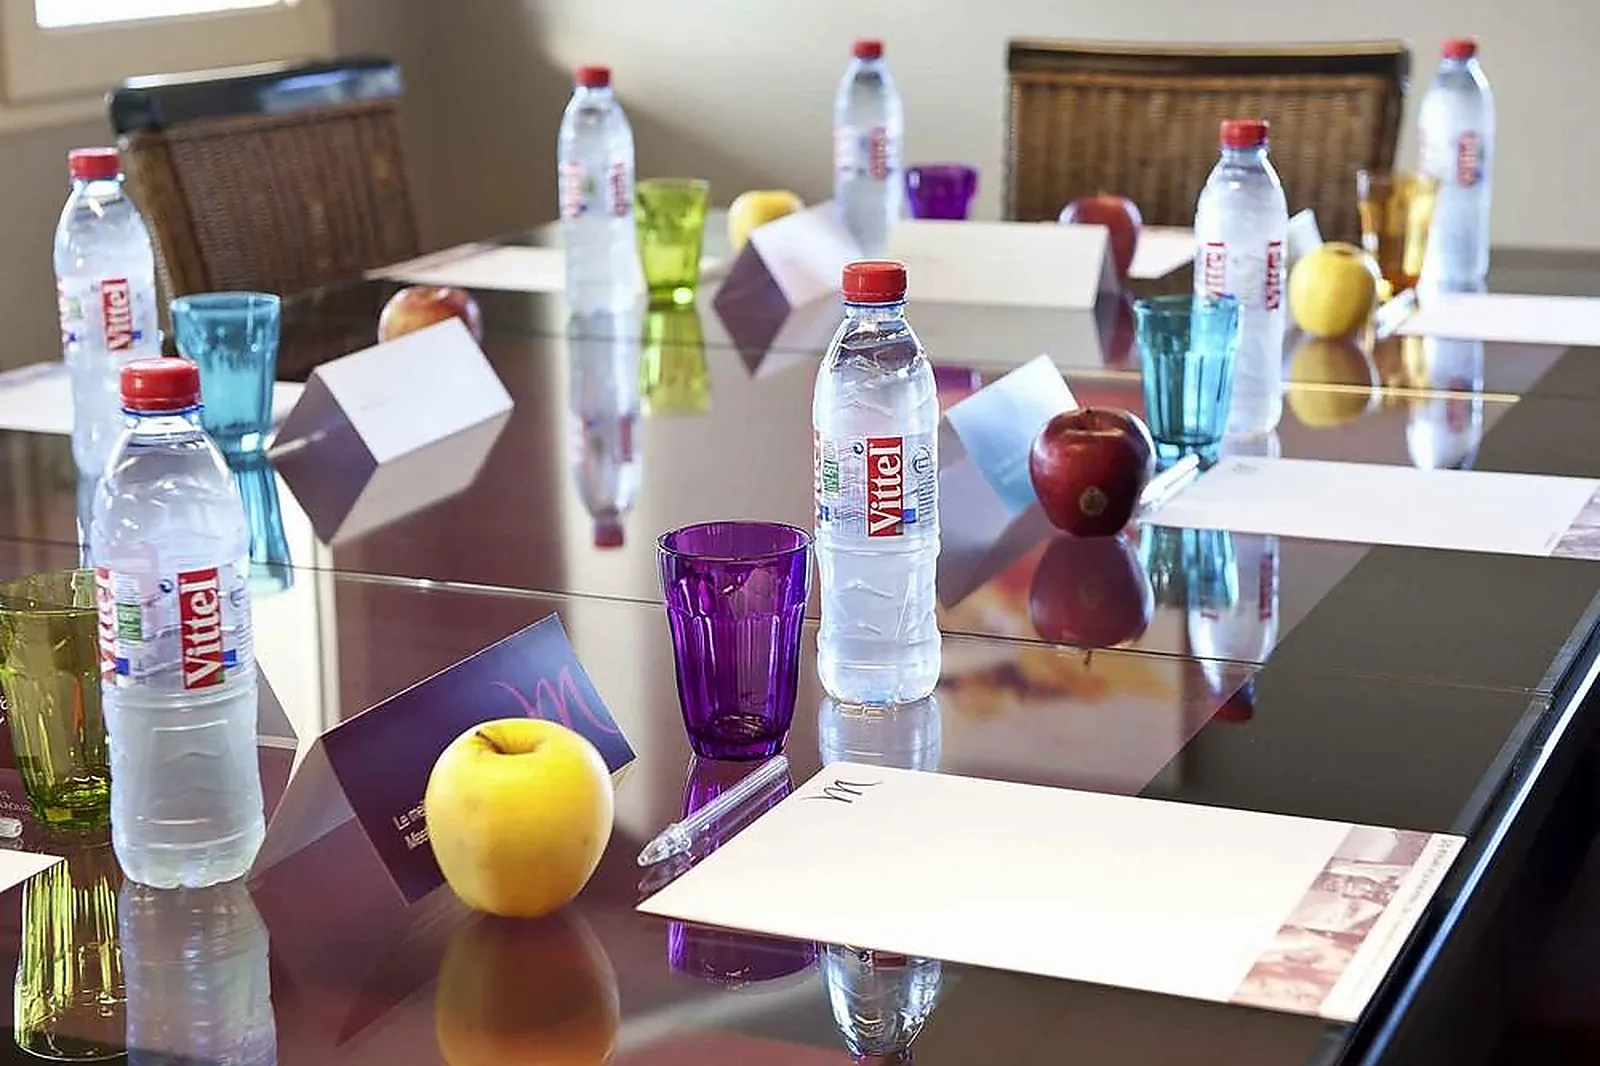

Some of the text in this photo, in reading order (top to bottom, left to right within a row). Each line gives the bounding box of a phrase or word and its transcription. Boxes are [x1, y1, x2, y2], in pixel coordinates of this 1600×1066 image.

[103, 282, 131, 350] Vittel
[869, 443, 902, 535] Vittel
[181, 577, 222, 688] Vittel
[404, 827, 430, 850] Mee
